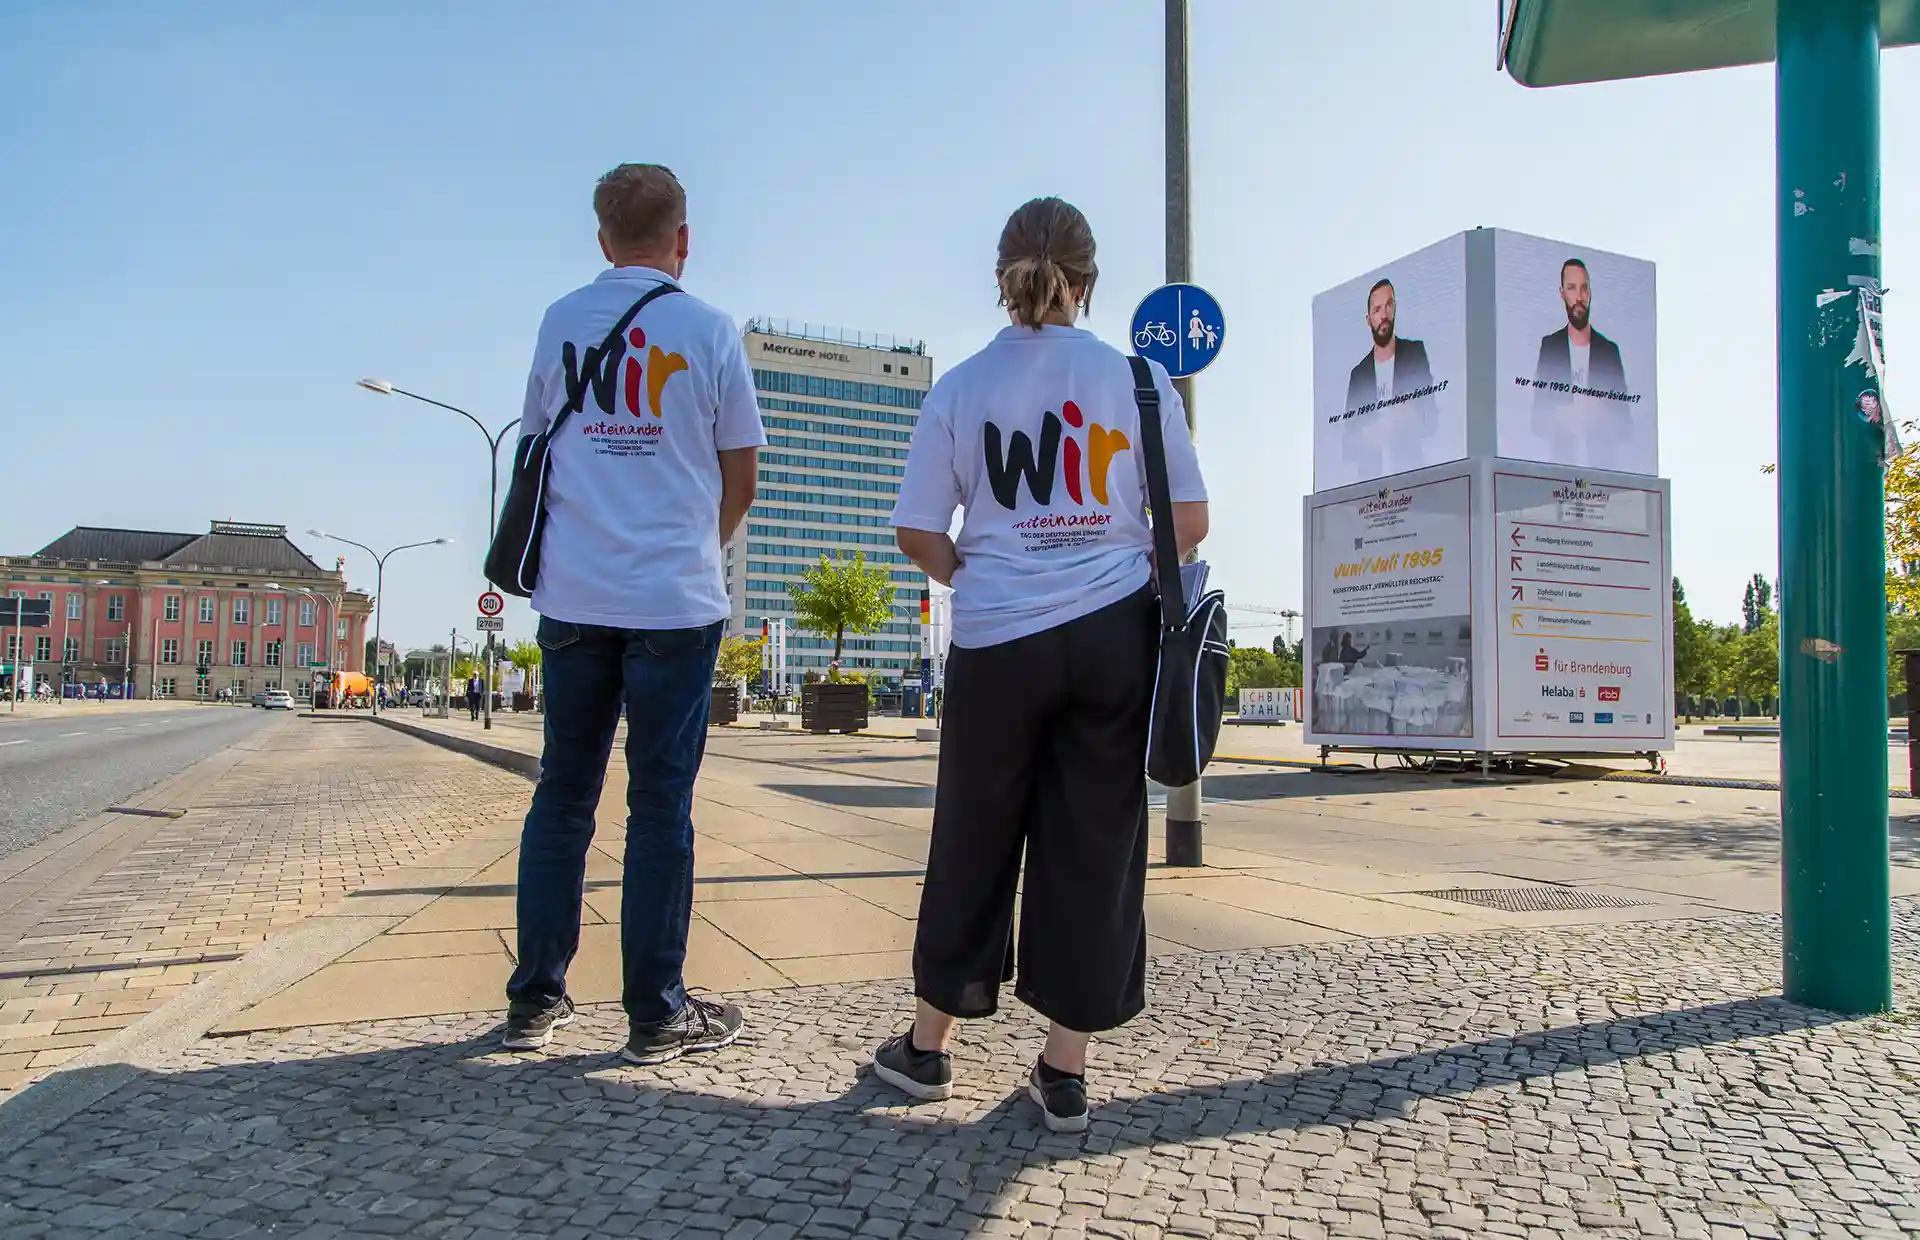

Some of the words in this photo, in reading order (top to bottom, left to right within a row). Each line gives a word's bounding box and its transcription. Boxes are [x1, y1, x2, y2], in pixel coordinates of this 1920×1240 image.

[763, 342, 817, 358] Mercure
[819, 351, 851, 363] HOTEL
[1515, 376, 1530, 386] Wer
[1532, 380, 1547, 389] war
[1549, 381, 1570, 393] 1990
[1571, 385, 1641, 404] Bundespräsident?
[1343, 410, 1355, 419] war
[1357, 404, 1375, 416] 1990
[1377, 380, 1448, 410] Bundespräsident?
[583, 421, 664, 436] miteinander
[1030, 543, 1063, 552] SEPTEMBER
[1402, 547, 1444, 569] 1995
[1333, 584, 1372, 594] KUNSTPROJEKT
[1554, 659, 1568, 674] für
[1570, 660, 1632, 678] Brandenburg
[1541, 685, 1574, 698] Helaba
[1599, 689, 1619, 699] rbb
[1242, 704, 1290, 716] STAHL!
